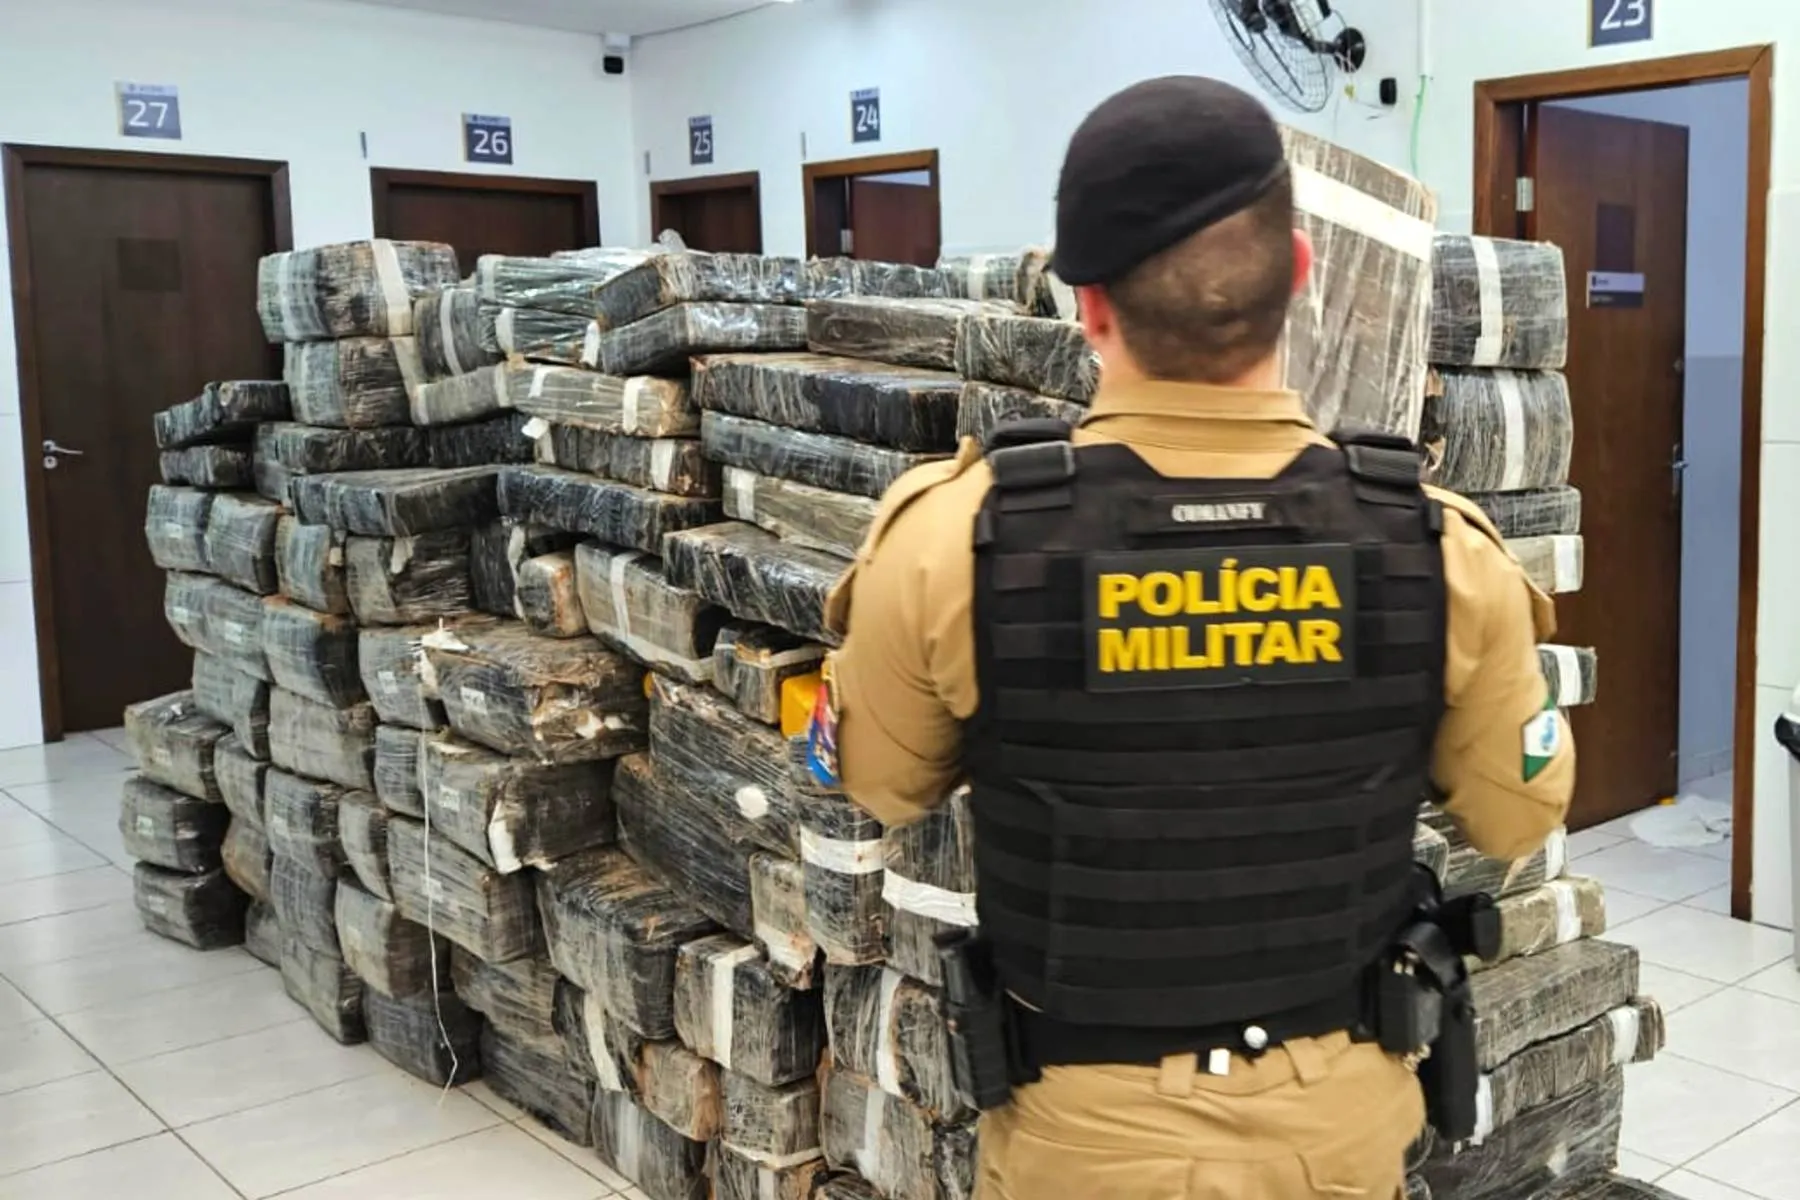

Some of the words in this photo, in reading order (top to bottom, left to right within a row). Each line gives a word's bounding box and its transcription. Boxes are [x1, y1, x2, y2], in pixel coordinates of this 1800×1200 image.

[1600, 0, 1646, 30] 23
[127, 100, 168, 129] 27
[856, 104, 878, 132] 24
[473, 129, 508, 155] 26
[694, 131, 711, 155] 25
[1098, 557, 1342, 618] POLÍCIA
[1098, 619, 1343, 672] MILITAR
